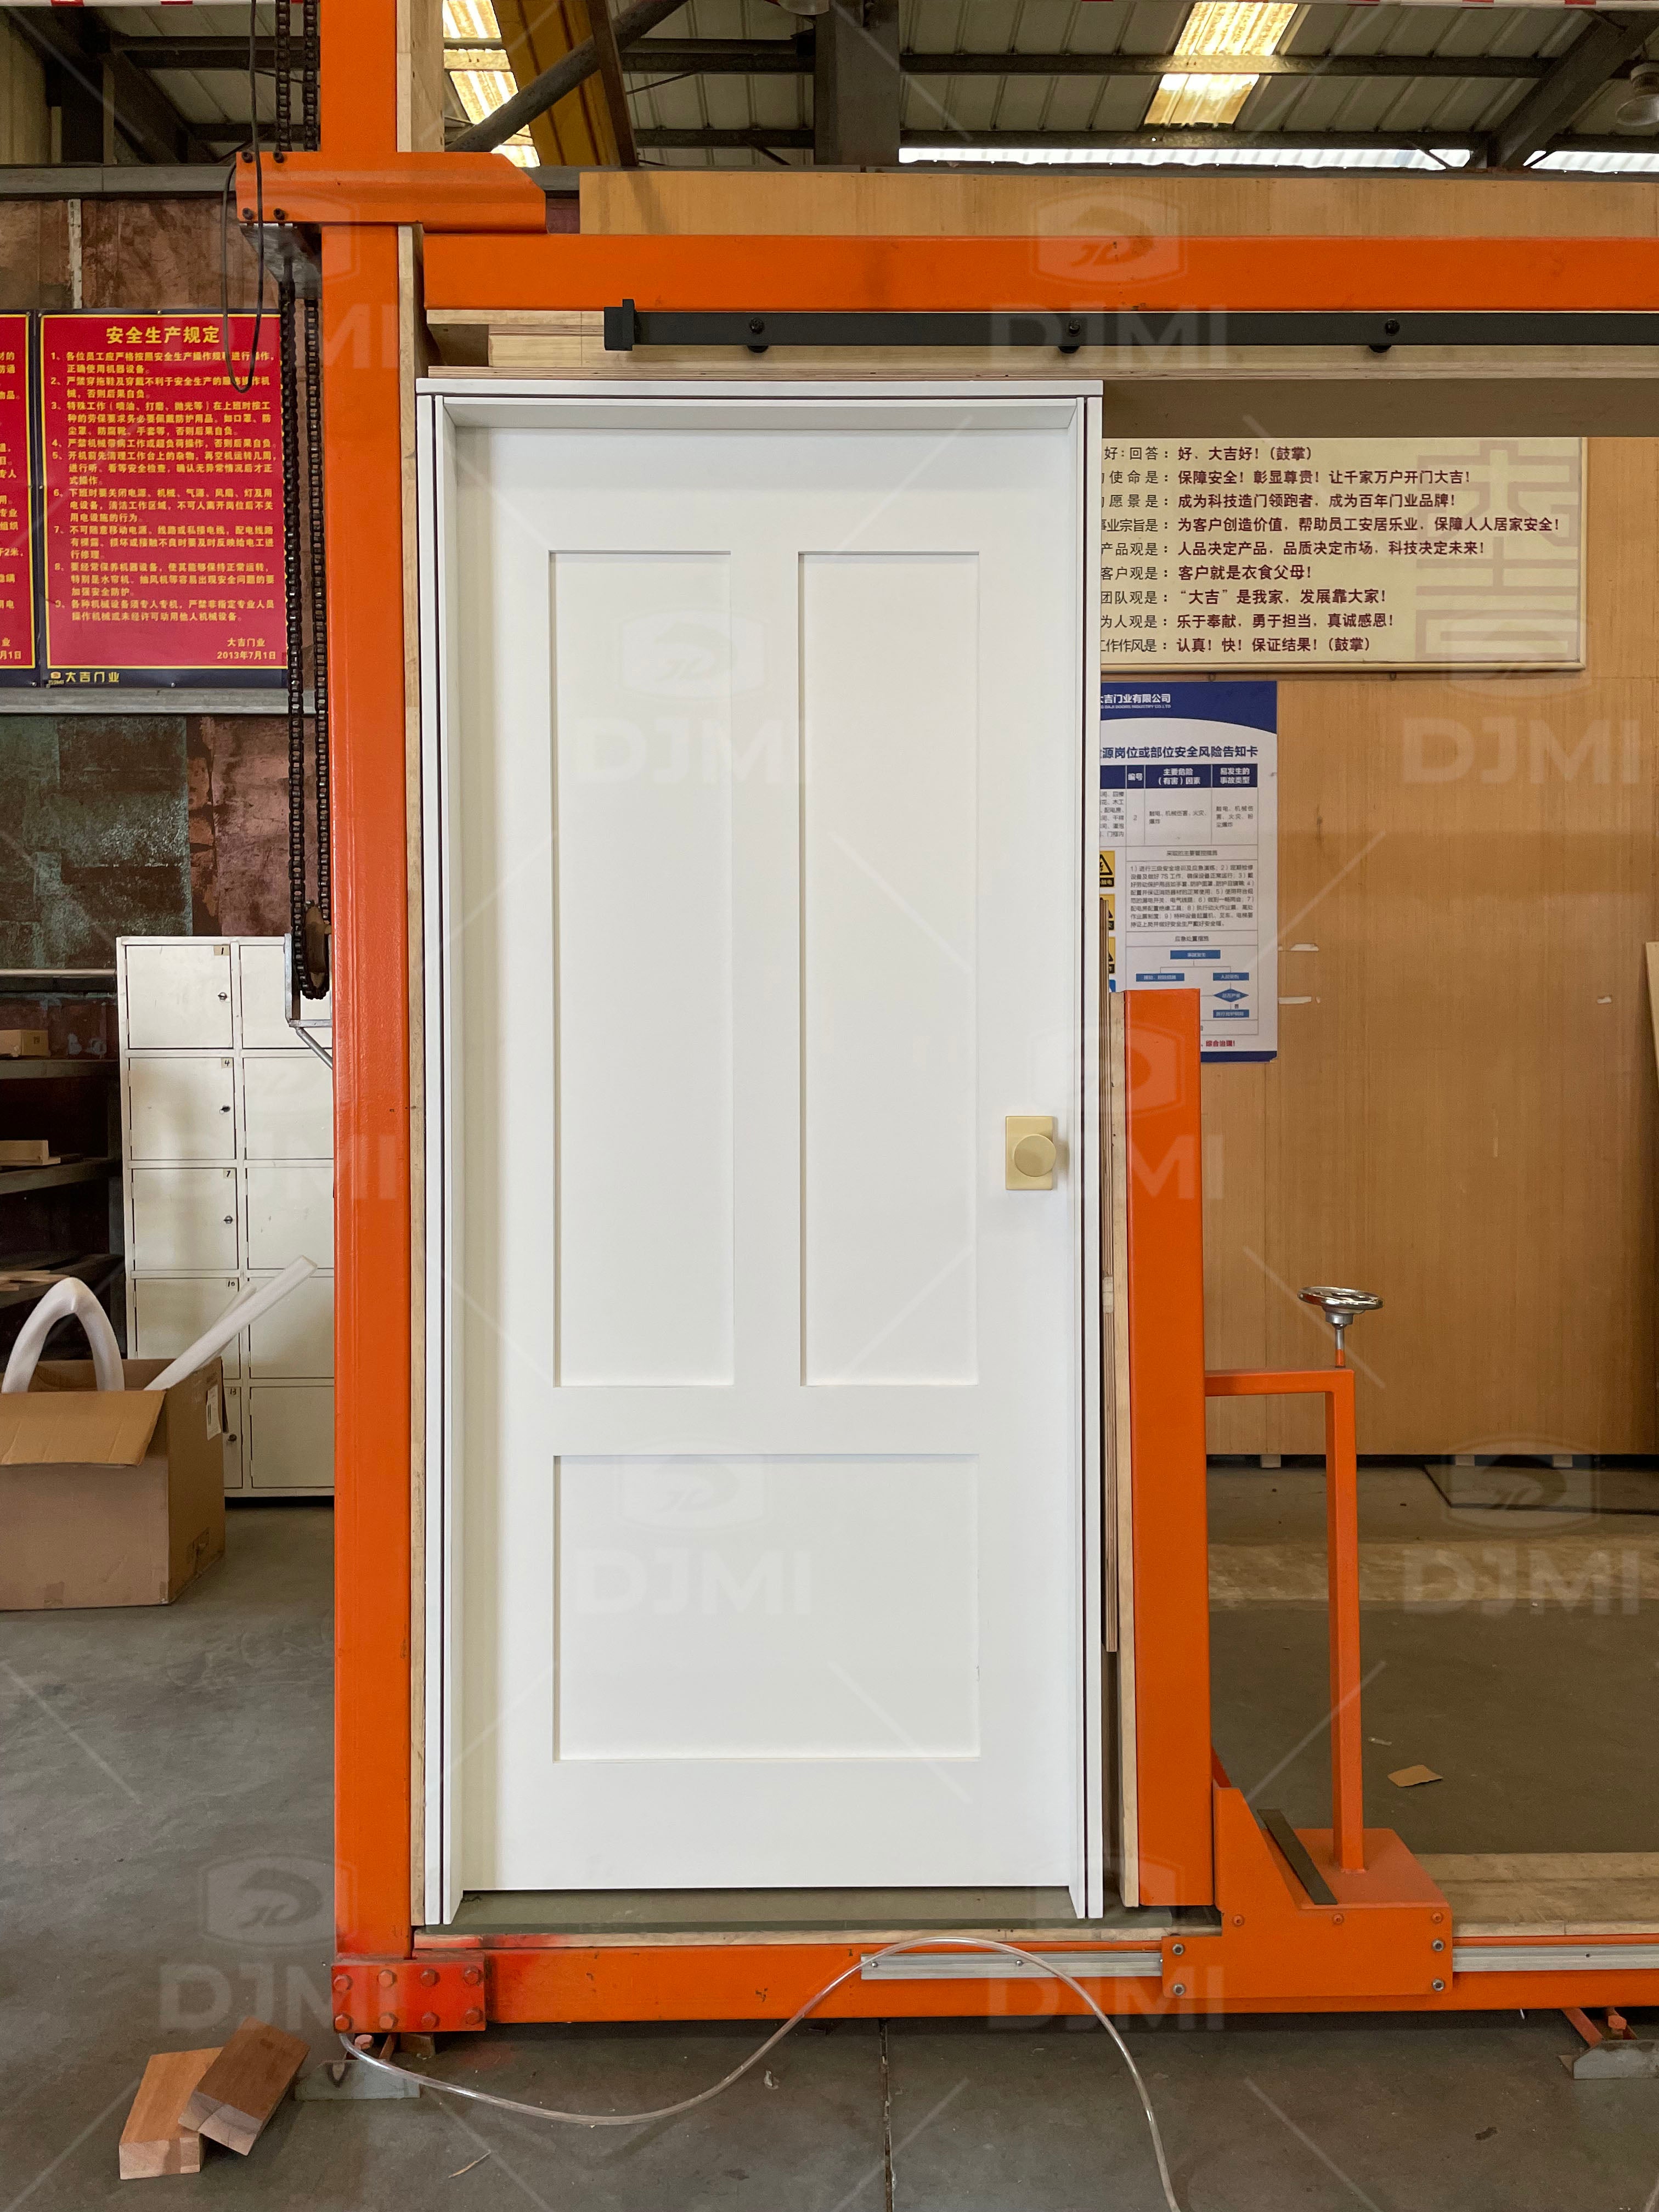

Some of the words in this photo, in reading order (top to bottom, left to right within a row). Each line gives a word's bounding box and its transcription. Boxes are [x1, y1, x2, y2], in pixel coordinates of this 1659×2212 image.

[106, 326, 219, 344] 安全生产规定
[1178, 564, 1311, 581] 客户就是衣食父母！
[227, 637, 266, 647] 大吉门业
[217, 651, 276, 660] 2013年7月1日
[65, 672, 120, 683] 大吉门业
[1100, 746, 1259, 759] 源岗位或部位安全风险告知卡
